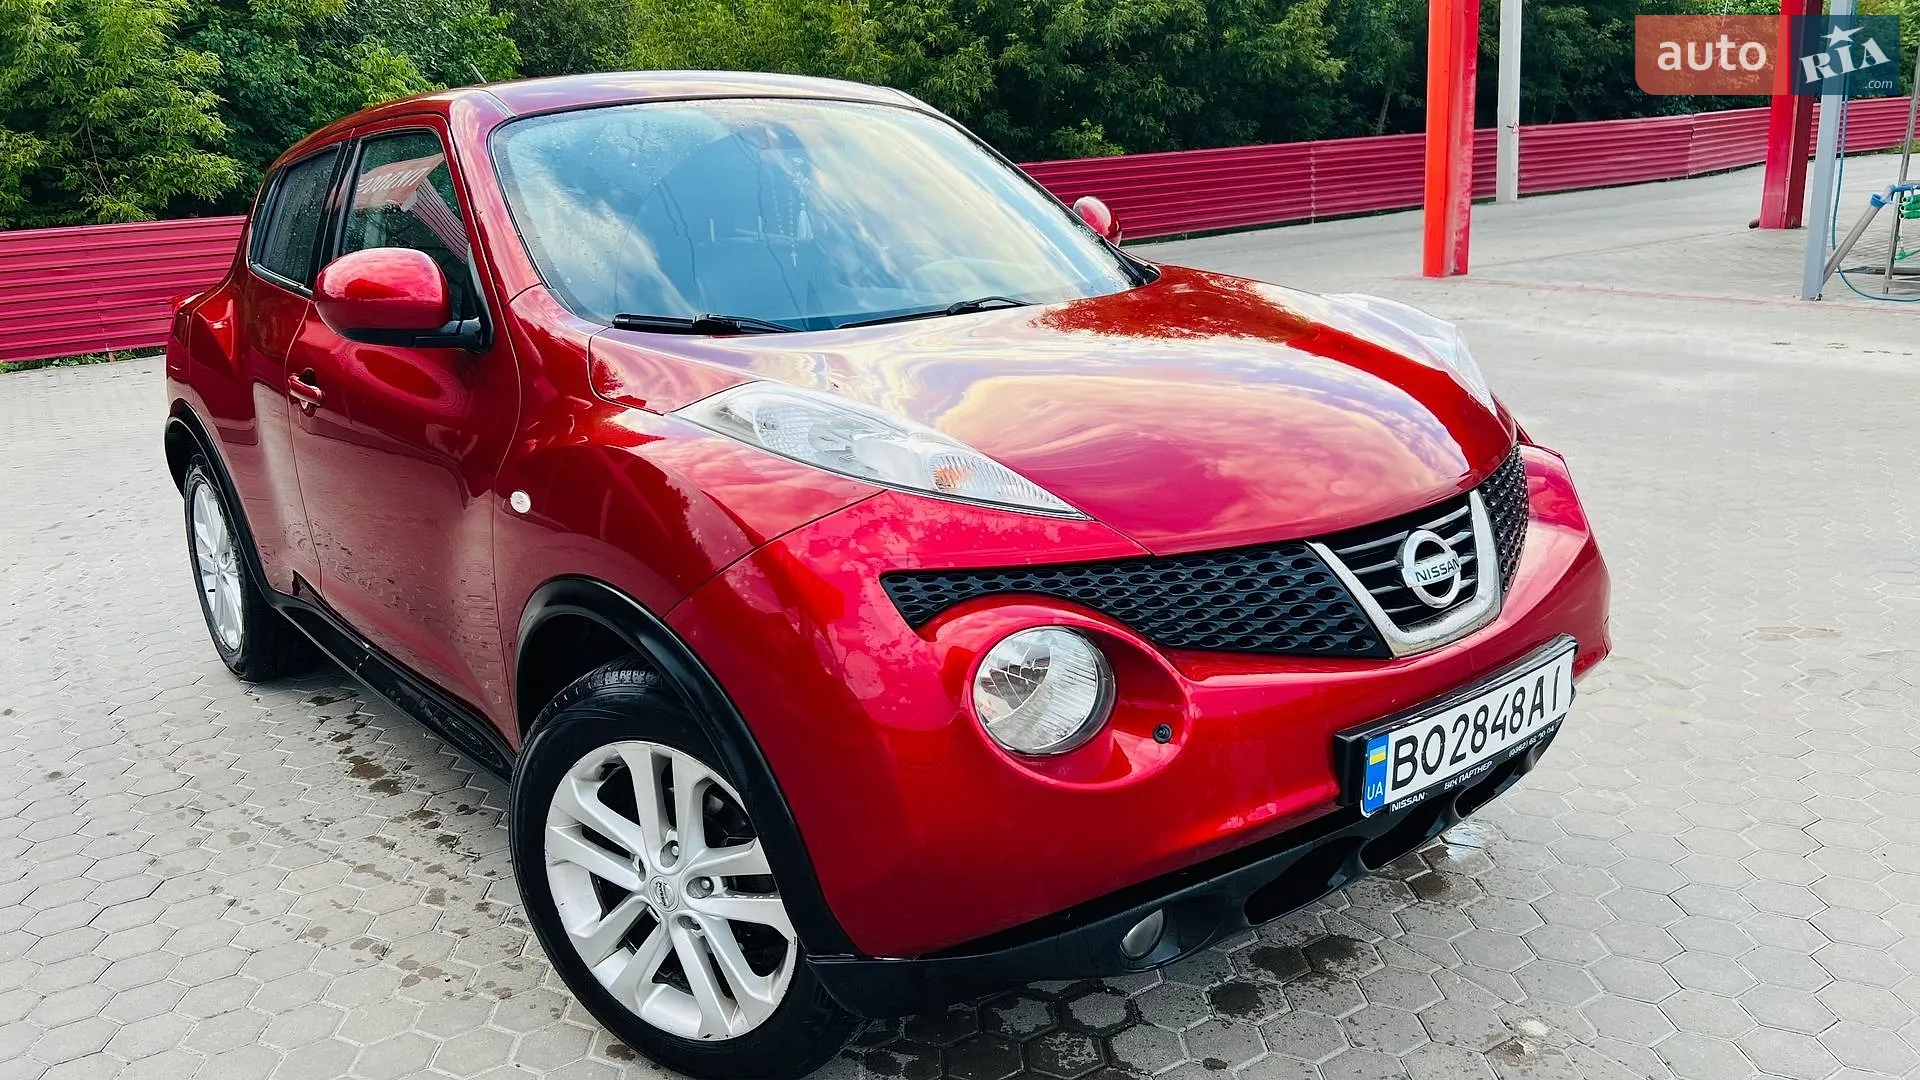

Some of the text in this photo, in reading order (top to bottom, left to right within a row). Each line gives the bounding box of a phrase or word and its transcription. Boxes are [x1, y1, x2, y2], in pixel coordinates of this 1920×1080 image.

[1414, 557, 1460, 583] NISSAN
[1366, 781, 1384, 801] UA
[1391, 791, 1426, 812] NISSAN
